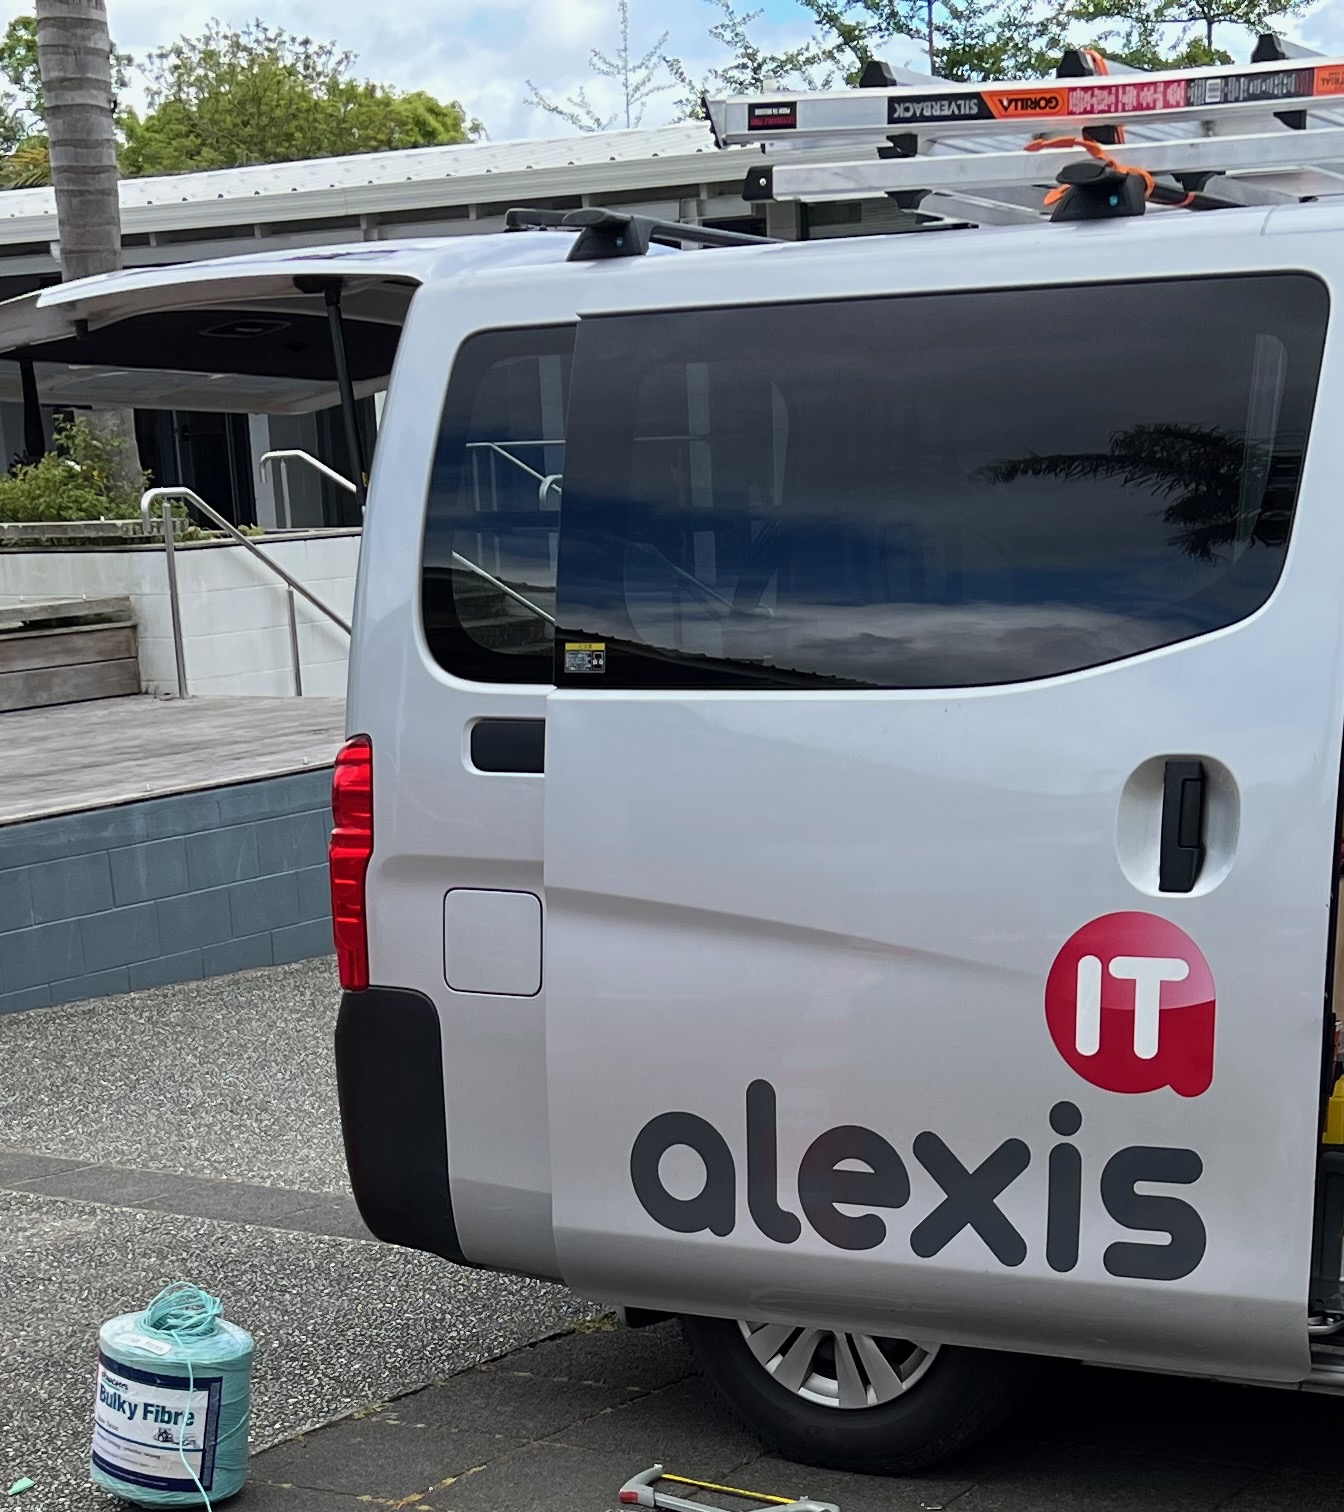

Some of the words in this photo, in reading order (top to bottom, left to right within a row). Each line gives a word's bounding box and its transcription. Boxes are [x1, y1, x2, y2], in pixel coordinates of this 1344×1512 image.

[893, 98, 978, 118] SILVERBACK
[1000, 96, 1059, 113] GORILLA
[1074, 954, 1191, 1061] IT
[629, 1078, 1207, 1282] alexis
[99, 1382, 138, 1421] Bulky
[142, 1401, 196, 1427] Fibre
